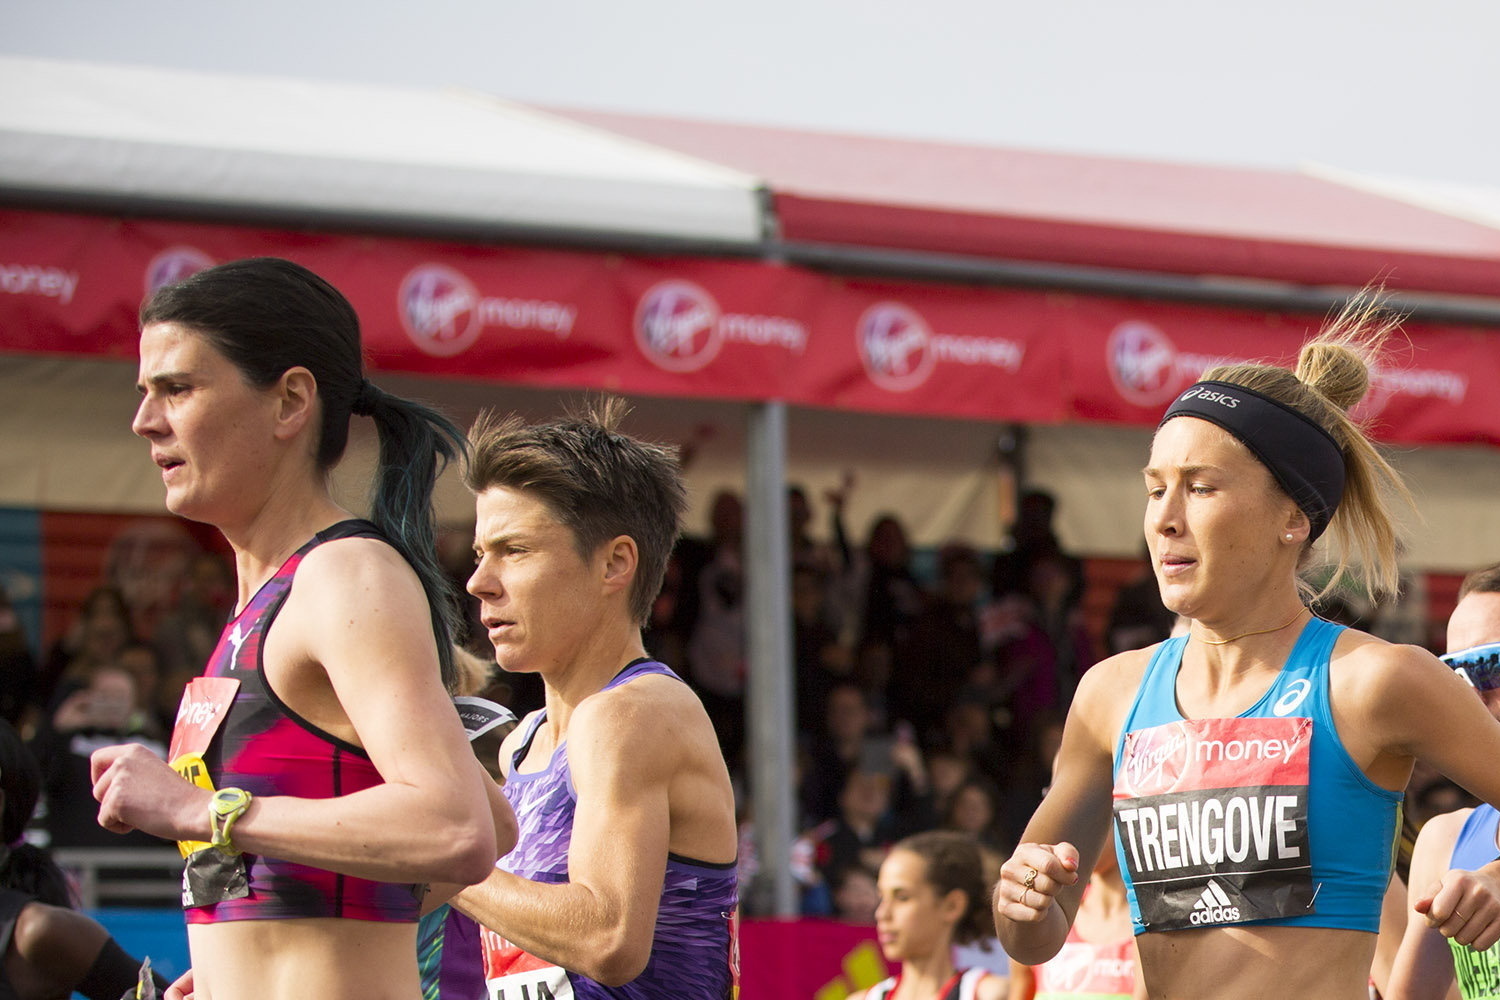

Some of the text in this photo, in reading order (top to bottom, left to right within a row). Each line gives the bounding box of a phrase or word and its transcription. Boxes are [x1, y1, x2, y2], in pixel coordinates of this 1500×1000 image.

[1197, 390, 1241, 408] asics
[1194, 738, 1300, 764] money
[1119, 795, 1300, 873] TRENGOVE
[1190, 906, 1240, 925] adidas
